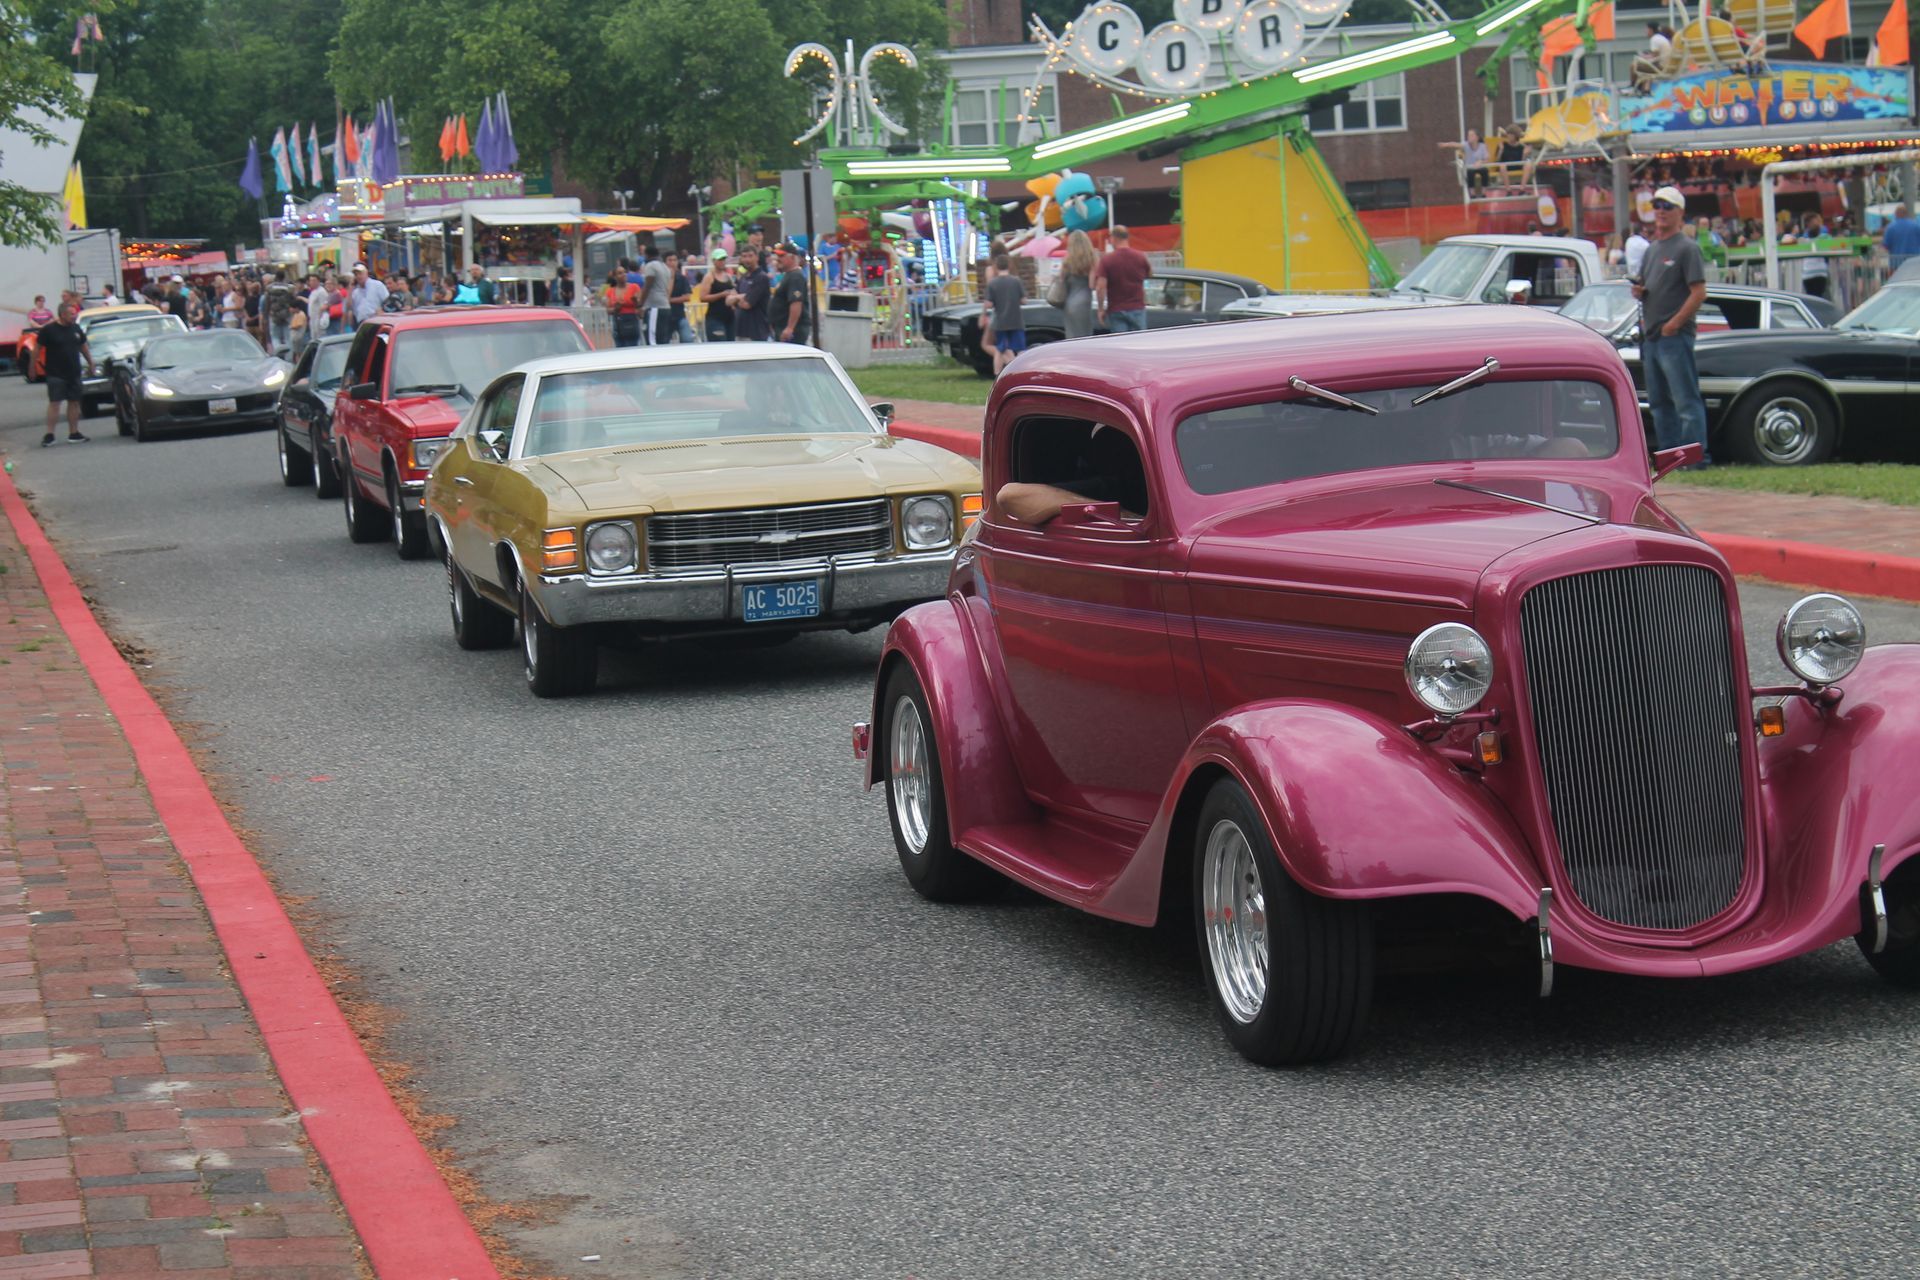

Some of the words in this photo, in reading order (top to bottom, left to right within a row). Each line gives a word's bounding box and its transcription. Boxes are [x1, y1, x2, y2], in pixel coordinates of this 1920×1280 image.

[1673, 71, 1852, 112] WATER
[1691, 106, 1748, 123] GUN
[1782, 101, 1837, 117] FUN
[747, 590, 766, 610] AC
[776, 585, 816, 607] 5025
[762, 609, 801, 617] MARYLAND
